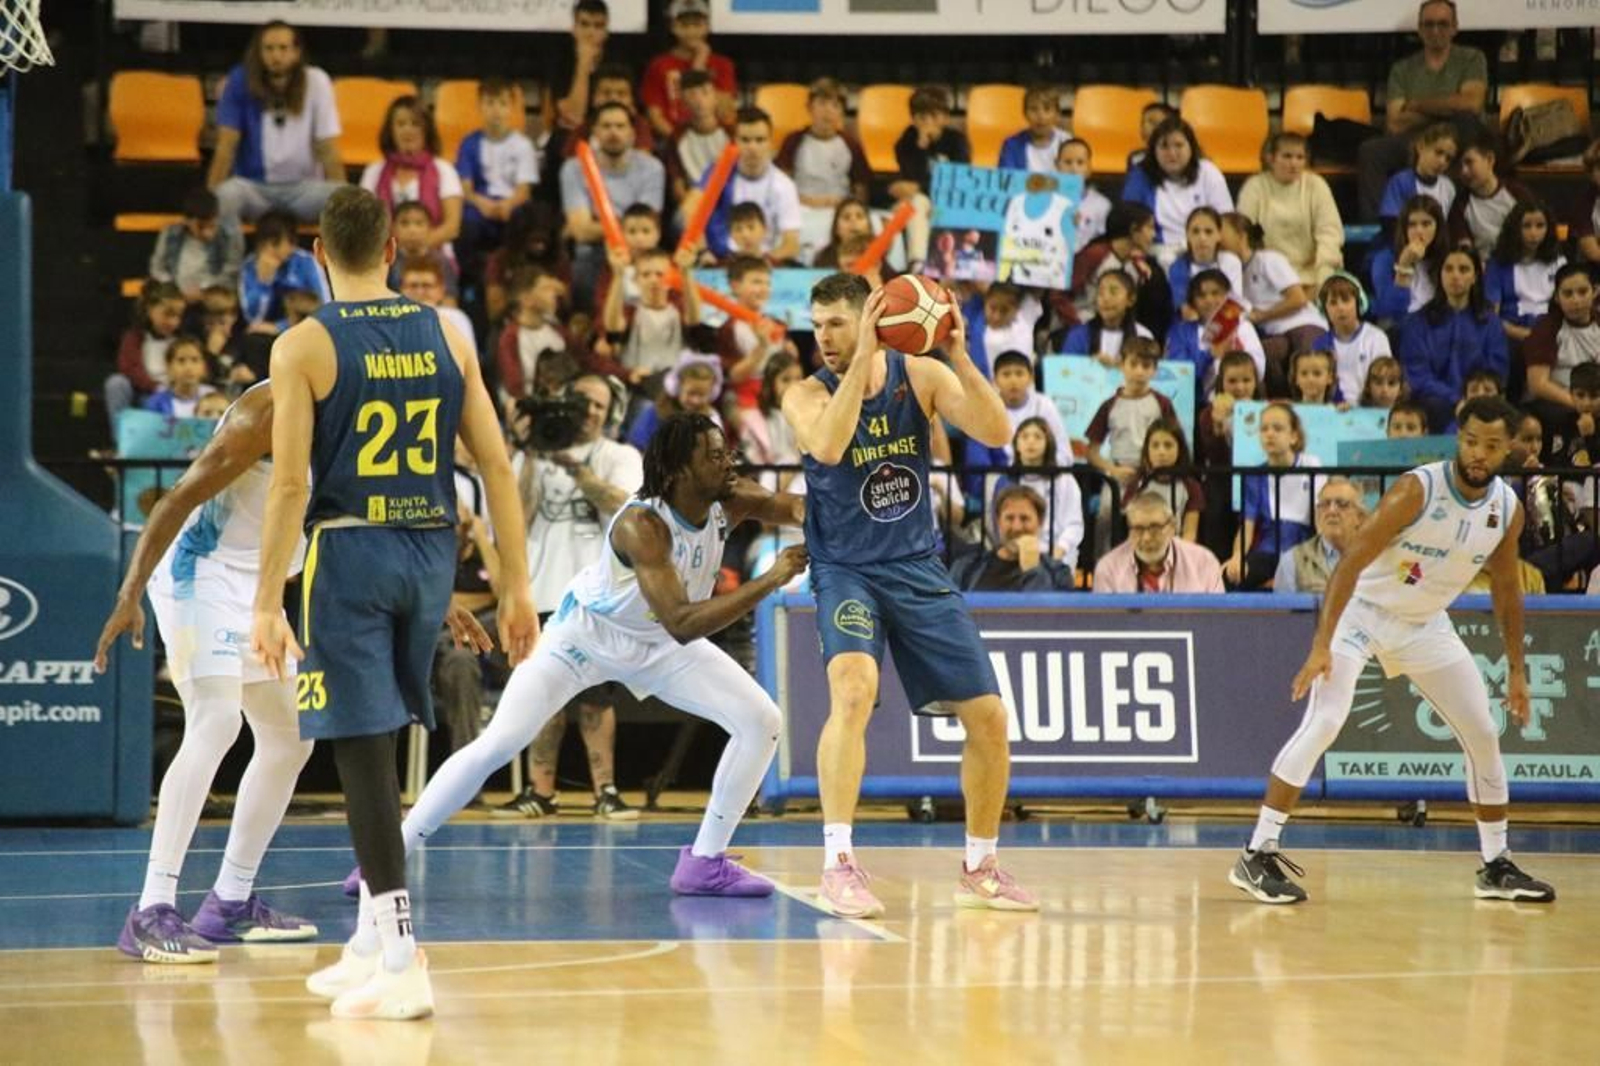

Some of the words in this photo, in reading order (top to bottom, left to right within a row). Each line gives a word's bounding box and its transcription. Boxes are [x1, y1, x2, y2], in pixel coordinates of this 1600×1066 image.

[868, 414, 889, 437] 41
[356, 398, 441, 476] 23
[852, 436, 918, 467] OURENSE
[870, 477, 909, 495] Estrella
[389, 496, 428, 508] XUNTA
[871, 490, 910, 509] Galicia
[388, 509, 404, 520] DE
[297, 671, 327, 711] 23
[1338, 762, 1389, 776] TAKE
[1397, 762, 1454, 776] AWAY
